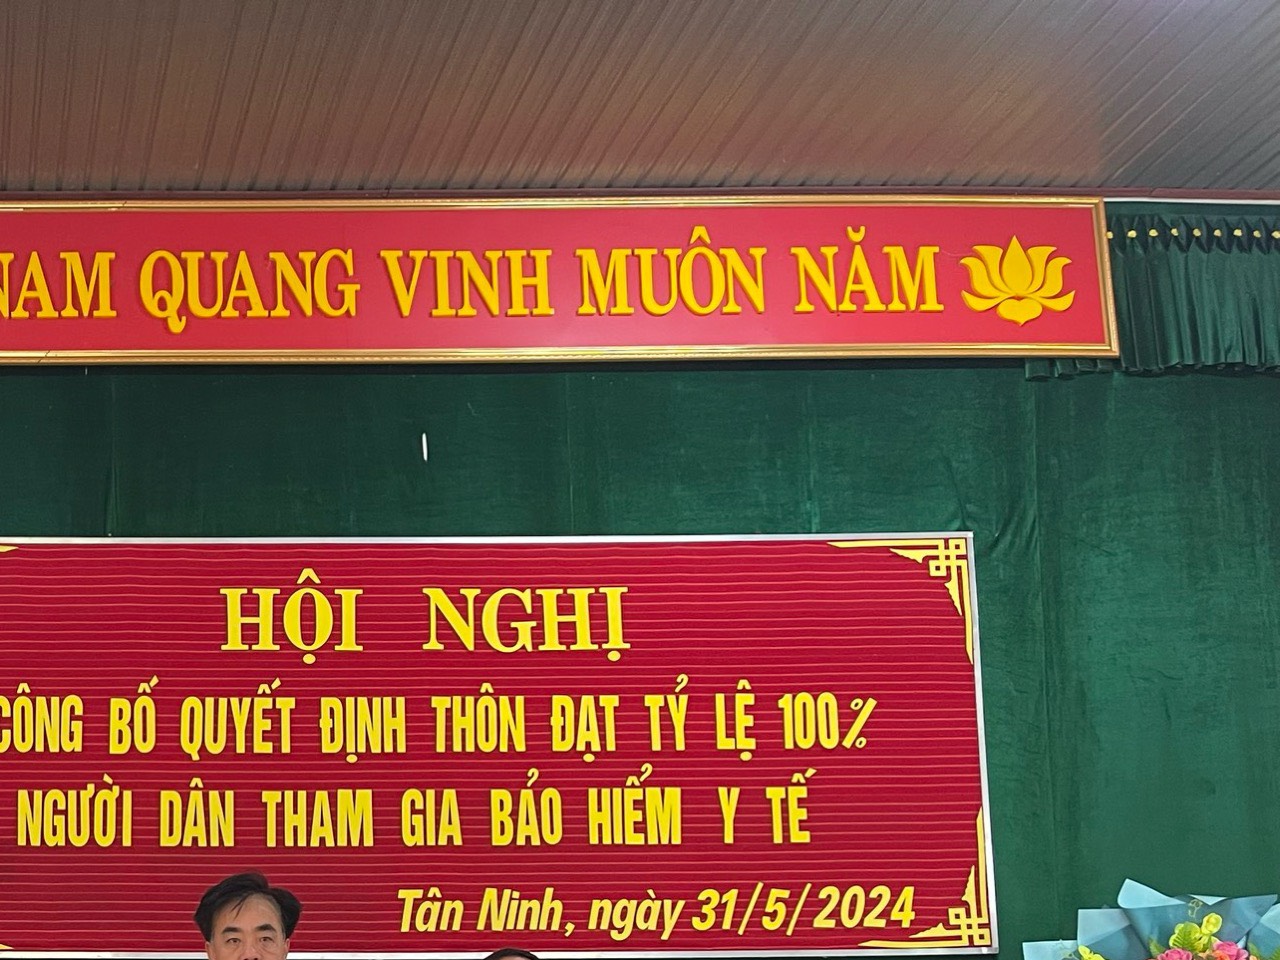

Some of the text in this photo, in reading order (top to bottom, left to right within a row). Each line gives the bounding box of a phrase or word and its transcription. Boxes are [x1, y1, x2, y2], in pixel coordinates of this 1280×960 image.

[138, 249, 360, 333] QUANG
[380, 249, 554, 316] VINH
[576, 225, 766, 315] MUÔN
[790, 226, 945, 312] NĂM
[220, 568, 629, 664] HỘI NGHỊ
[109, 676, 157, 755] BỐ
[180, 677, 296, 761] QUYẾT
[319, 695, 407, 763] ĐỊNH
[430, 682, 526, 754] THÔN
[550, 694, 619, 762] ĐẠT
[643, 673, 688, 751] TỶ
[714, 680, 756, 761] LỆ
[777, 691, 877, 749] 100%
[17, 763, 815, 847] NGƯỜI DÂN THAM GIA BẢO HIỂM Y TẾ
[397, 882, 916, 940] Tân Ninh, ngày 31/5/2024
